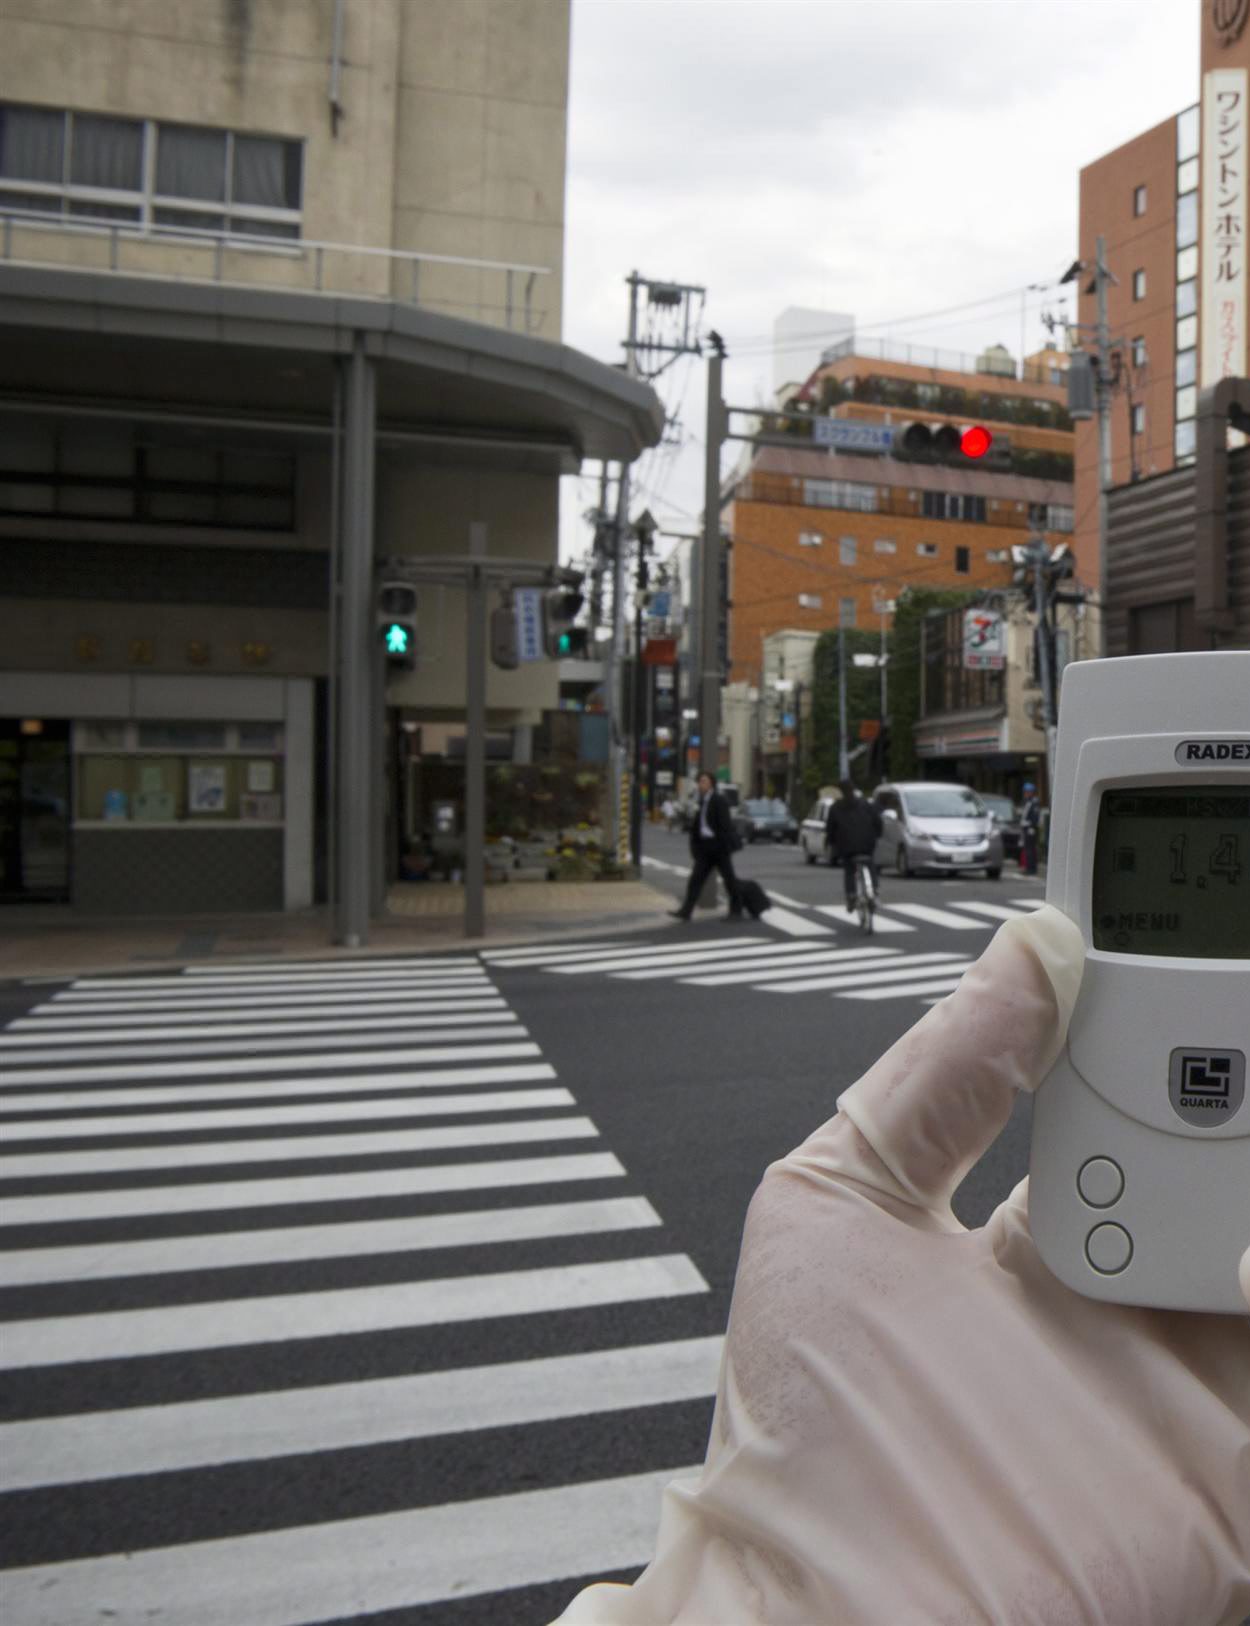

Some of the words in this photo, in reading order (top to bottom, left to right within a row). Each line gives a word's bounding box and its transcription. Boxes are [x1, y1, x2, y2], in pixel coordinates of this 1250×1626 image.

[1215, 91, 1240, 282] ワシントンホテル
[1119, 912, 1181, 931] MENU
[1180, 1097, 1229, 1109] QUARTA
